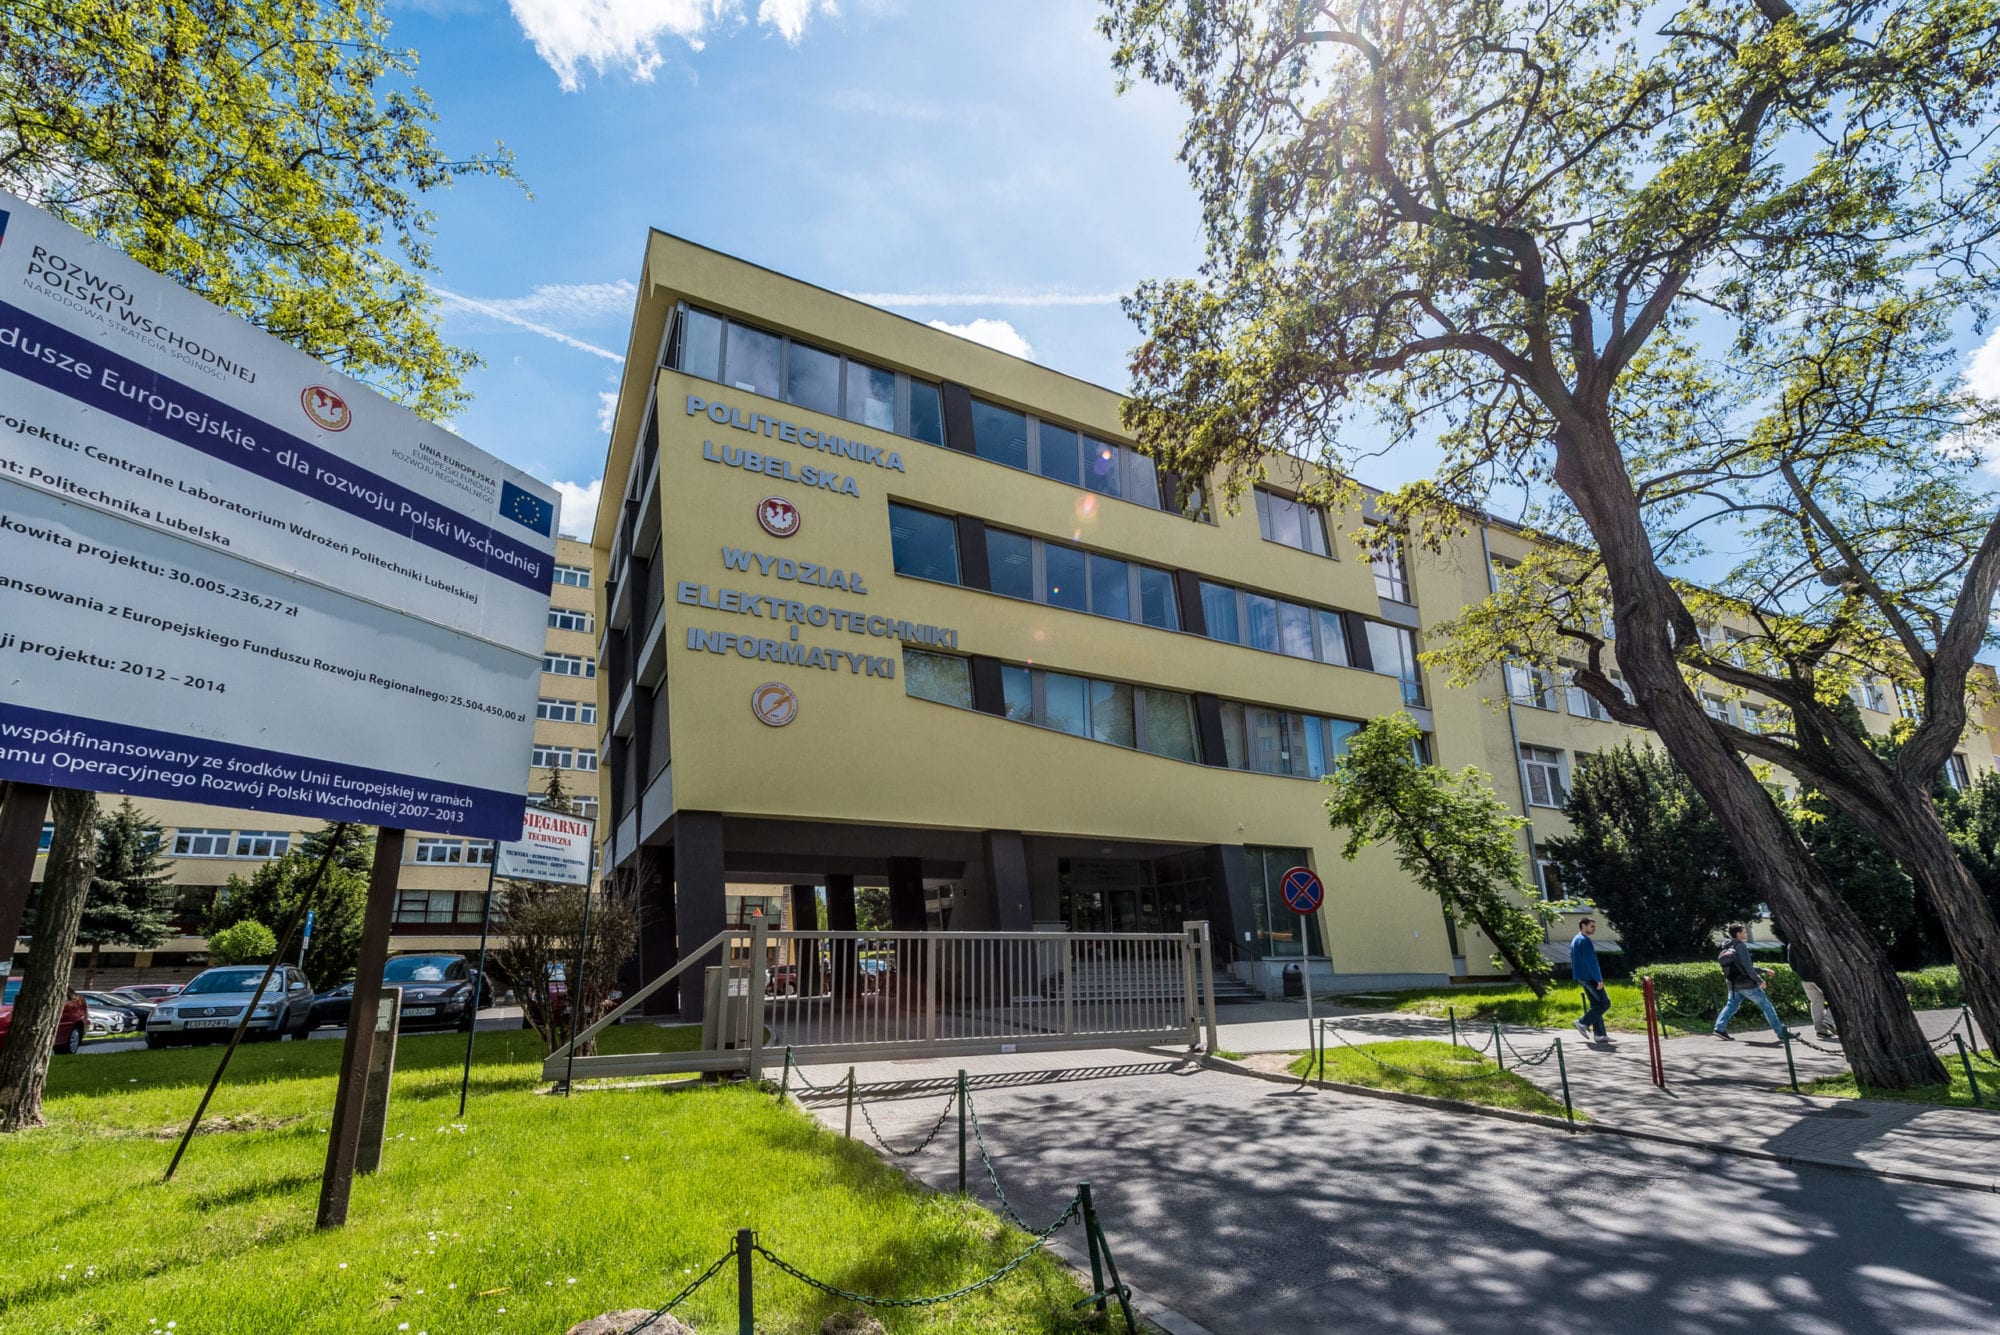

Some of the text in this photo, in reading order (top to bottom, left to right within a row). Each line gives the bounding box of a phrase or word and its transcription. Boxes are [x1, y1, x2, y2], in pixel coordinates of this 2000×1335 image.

[32, 245, 135, 306] ROZWÓJ
[23, 278, 227, 381] NARODOWA STRATEGIA SPÓJNOŚCI
[28, 261, 257, 384] POLSKI WSCHODNIEJ
[0, 326, 93, 381] dusze
[101, 367, 256, 451] Europejskie
[276, 450, 310, 476] dla
[315, 467, 395, 513] rozwoju
[400, 501, 450, 536] Polski
[454, 525, 540, 579] Wschodniej
[419, 442, 496, 487] UNIA EUROPEJSKA
[686, 394, 906, 474] POLITECHNIKA
[391, 449, 494, 505] ROZWOJU REGIONALNEGO
[412, 449, 496, 497] EUROPEJSKI FUNDUSZ
[703, 439, 860, 498] LUBELSKA
[29, 466, 151, 520] Politechnika
[155, 511, 231, 547] Lubelska
[85, 445, 174, 489] Centralne
[178, 480, 286, 531] Laboratorium
[290, 521, 349, 554] Wdrożeń
[352, 547, 422, 583] Politechniki
[424, 575, 479, 605] Lubelskiej
[0, 514, 298, 617] kowita projektu: 30.005.236,27 zł
[722, 545, 868, 595] WYDZIAŁ
[676, 580, 959, 650] ELEKTROTECHNIKI
[790, 625, 799, 641] I
[0, 576, 526, 723] ansowania z Europejskiego Funduszu Rozwoju Regionalnego: 25.504.450,00 zł
[20, 638, 116, 670] projektu:
[119, 659, 166, 681] 2012
[183, 674, 226, 694] 2014
[686, 626, 896, 680] INFORMATYKI
[2, 723, 200, 768] współfinansowany
[203, 755, 223, 770] ze
[227, 755, 297, 781] środków
[301, 768, 330, 786] Unii
[333, 775, 415, 802] Europejskiej
[417, 791, 429, 800] w
[430, 792, 473, 809] ramach
[52, 752, 197, 788] Operacyjnego
[201, 773, 264, 798] Rozwój
[268, 784, 312, 803] Polski
[315, 790, 396, 816] Wschodniej
[523, 812, 588, 837] SIĘGARNIA
[527, 831, 572, 847] TECHNICZNA
